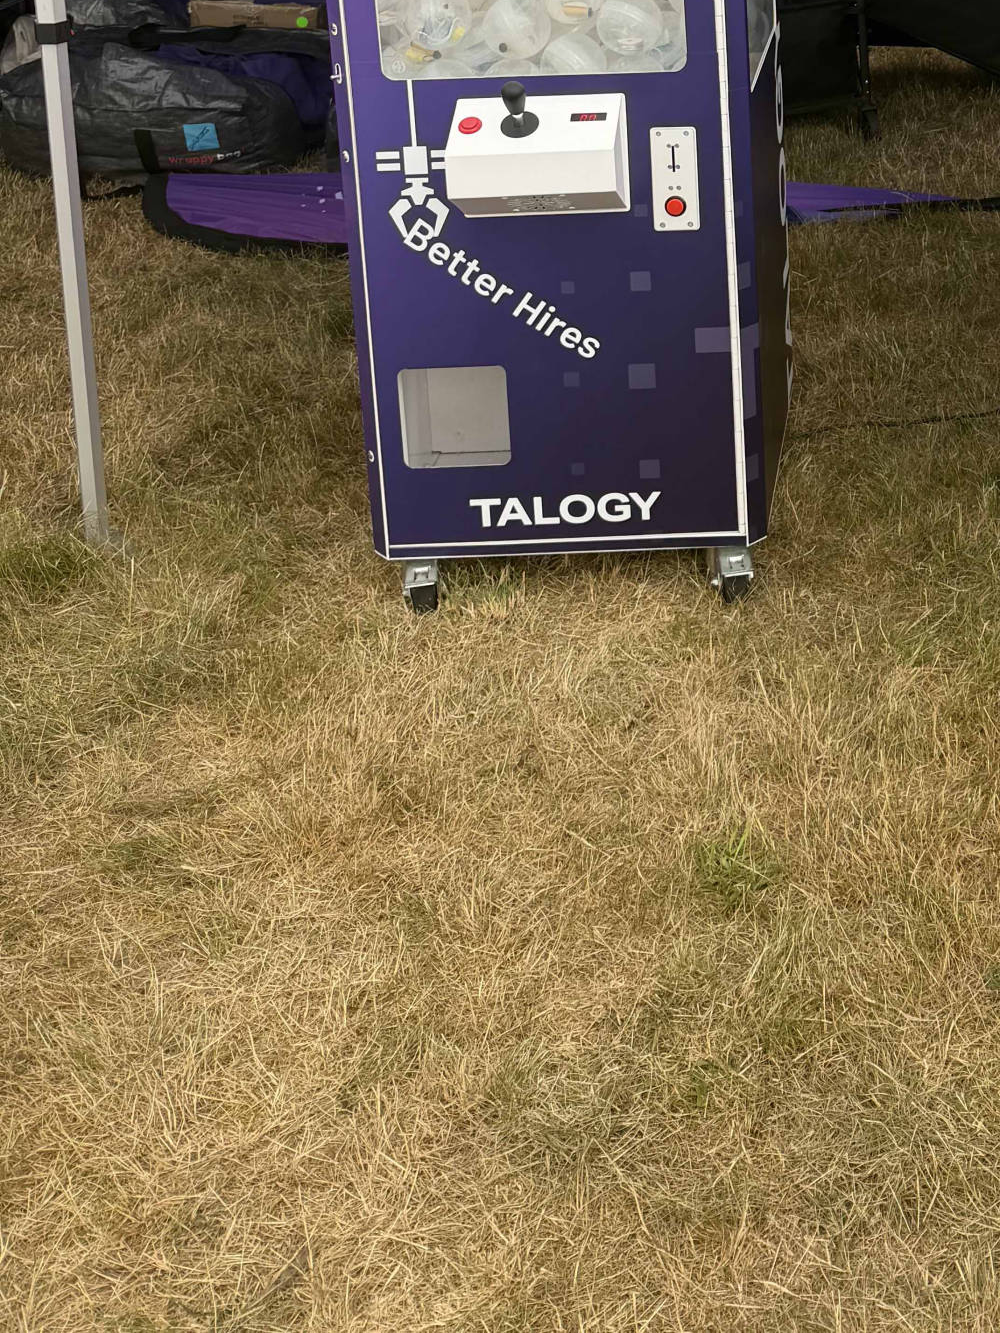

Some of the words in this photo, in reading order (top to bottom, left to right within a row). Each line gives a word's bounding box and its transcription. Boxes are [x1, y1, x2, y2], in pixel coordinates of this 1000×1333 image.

[403, 218, 514, 304] Better
[512, 292, 600, 358] Hires
[469, 491, 661, 527] TALOGY
